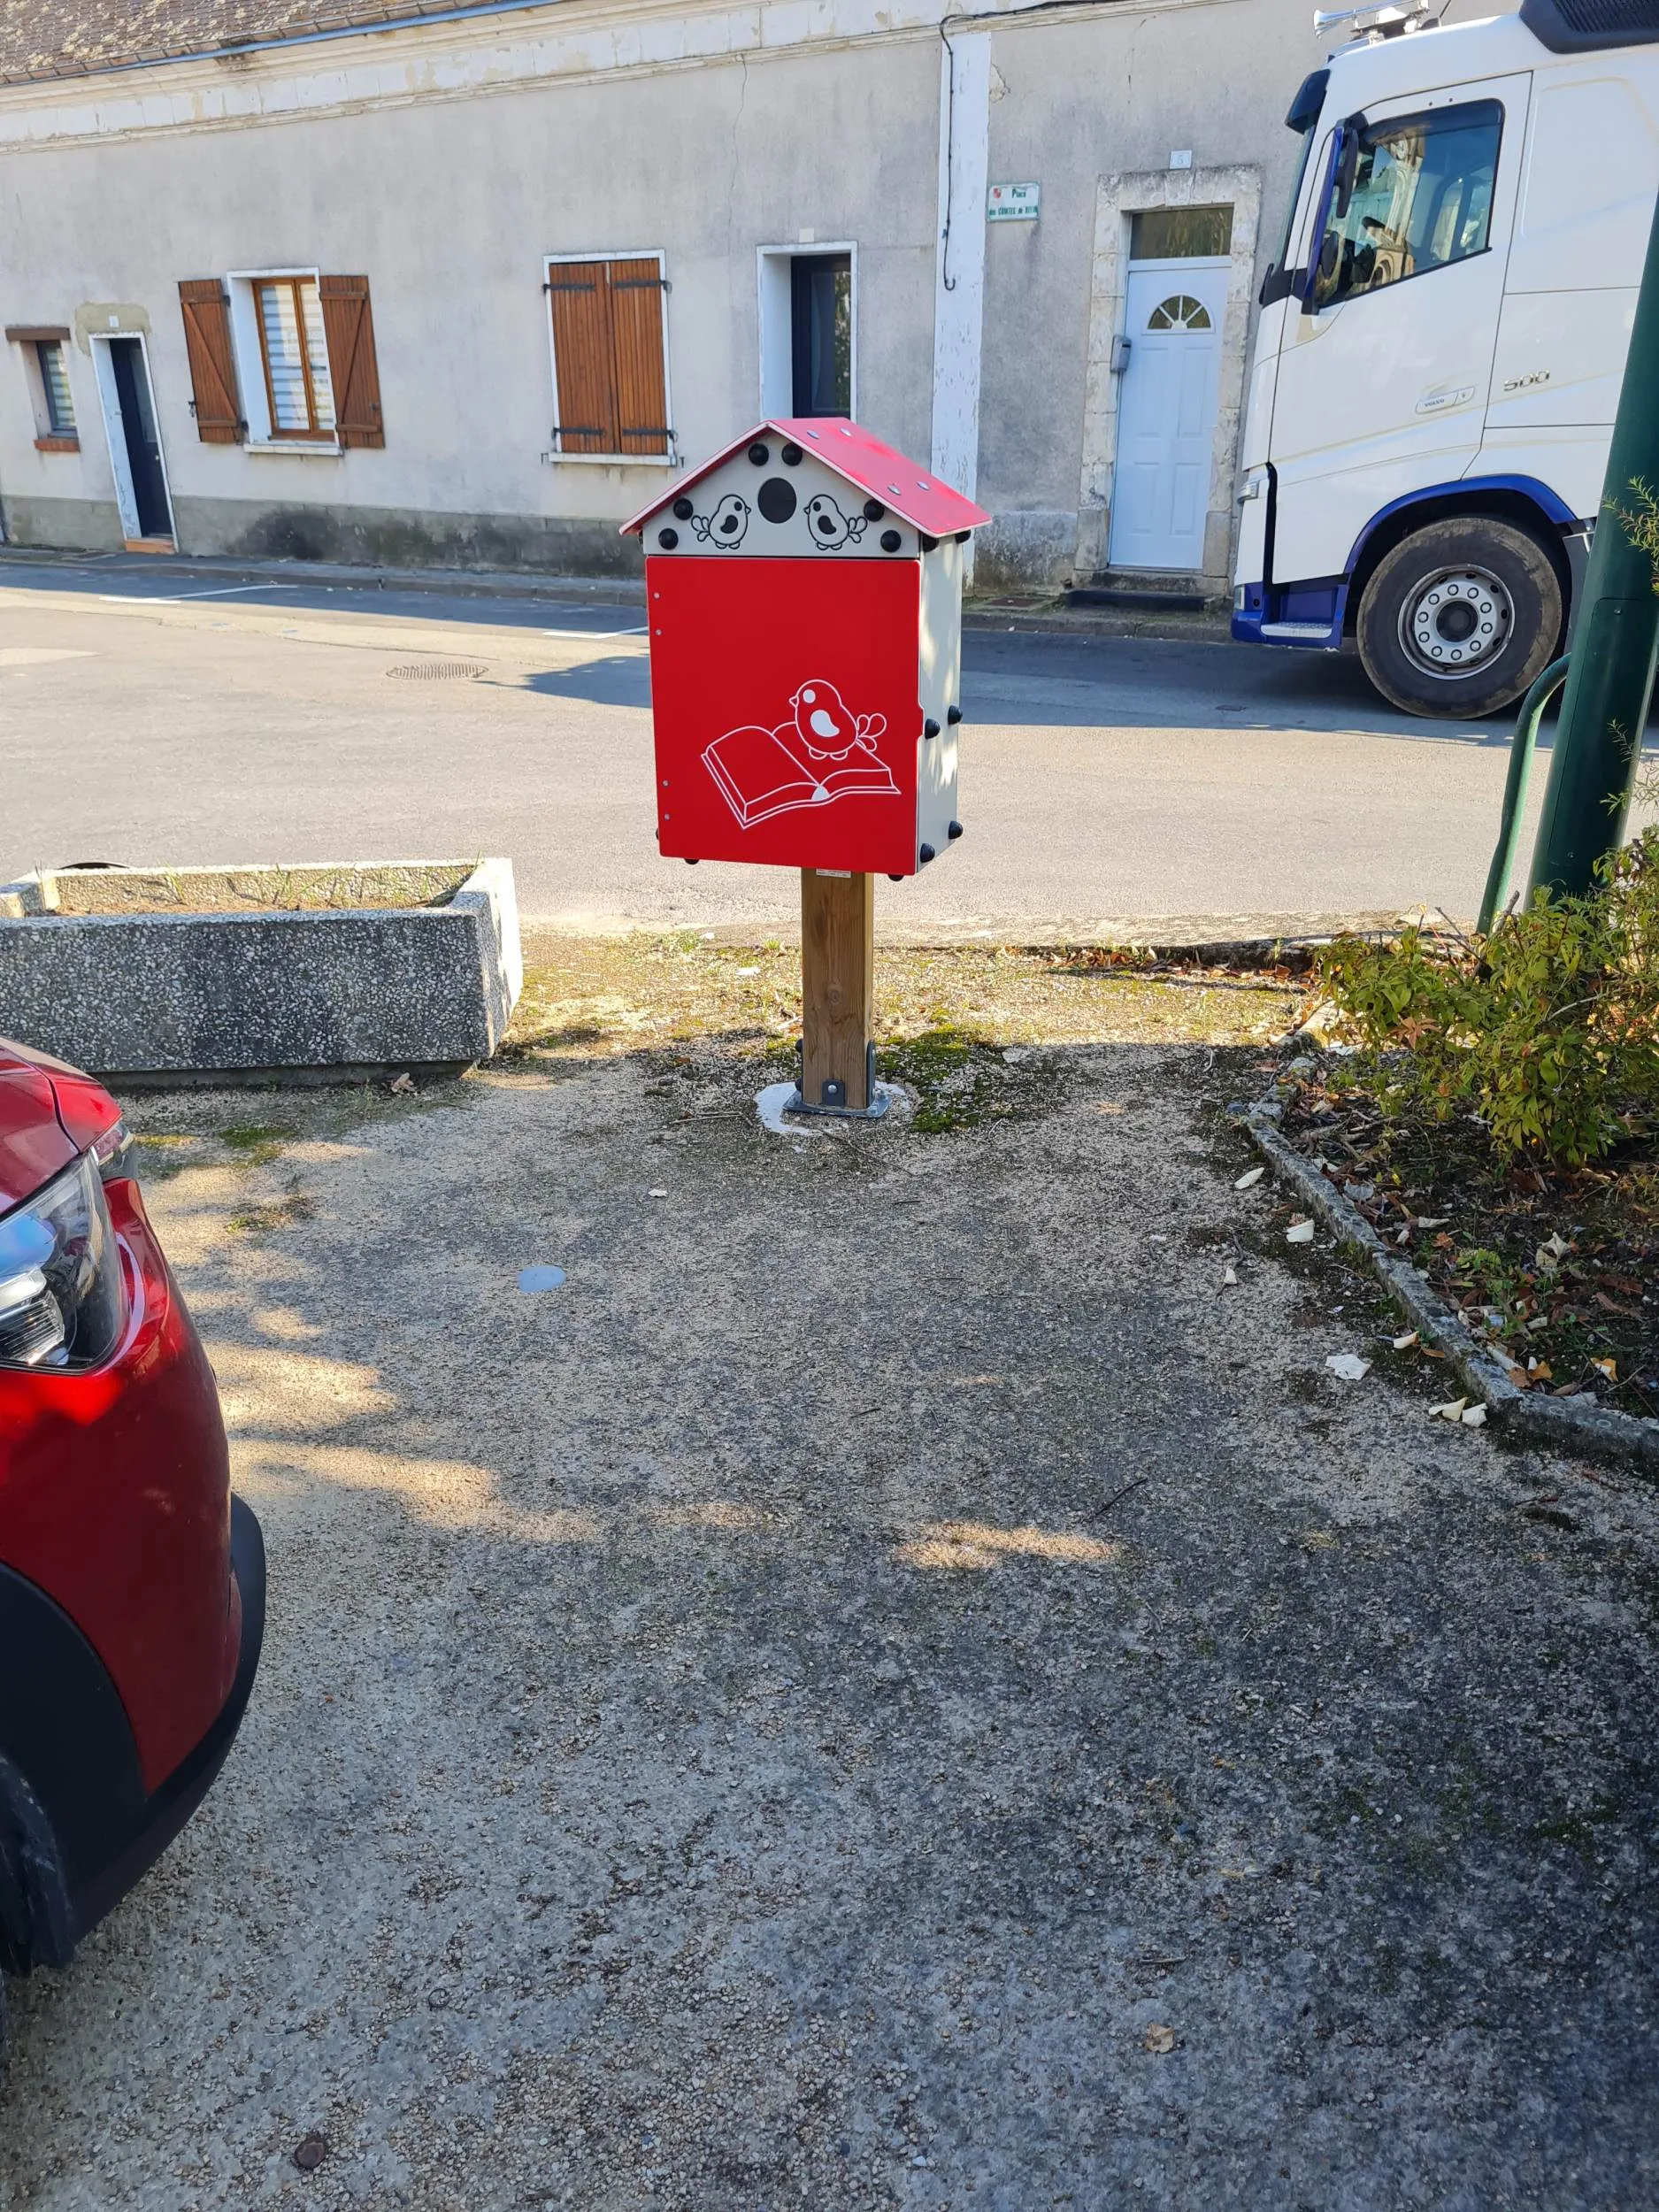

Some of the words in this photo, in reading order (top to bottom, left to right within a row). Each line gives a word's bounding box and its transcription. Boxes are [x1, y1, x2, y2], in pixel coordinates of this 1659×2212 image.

[1011, 188, 1026, 198] Place
[1503, 368, 1551, 392] 500
[1424, 397, 1445, 408] VOLVO
